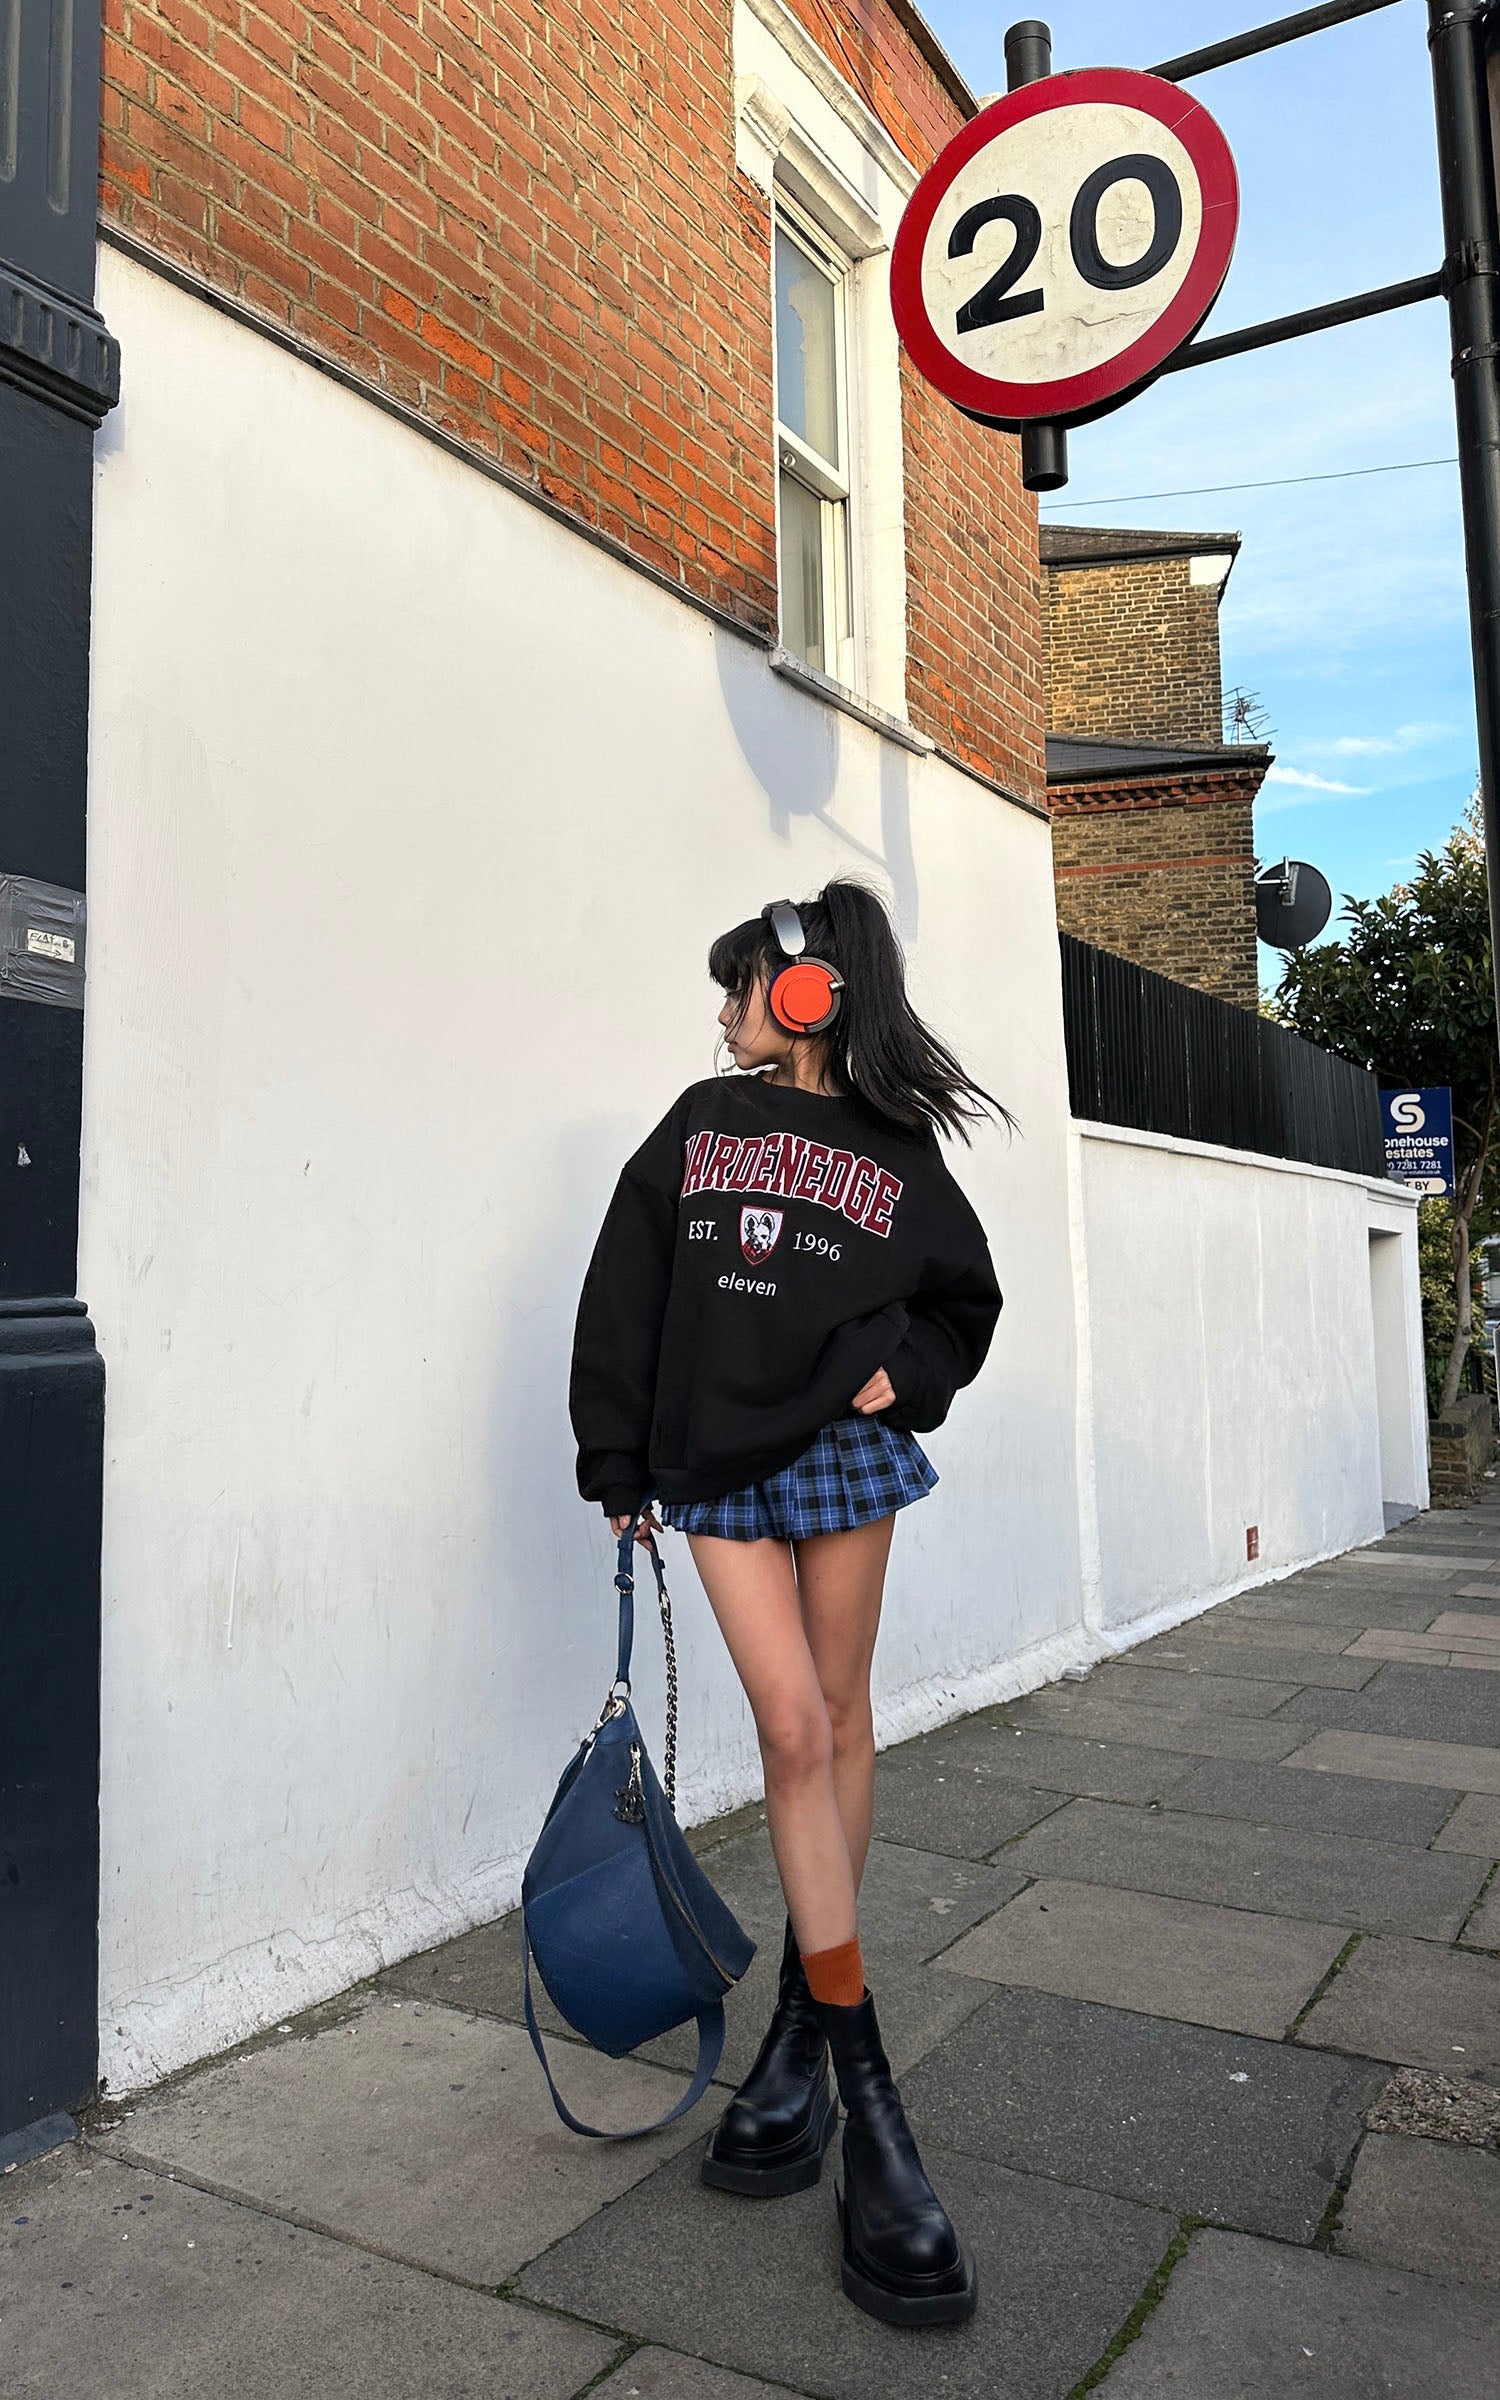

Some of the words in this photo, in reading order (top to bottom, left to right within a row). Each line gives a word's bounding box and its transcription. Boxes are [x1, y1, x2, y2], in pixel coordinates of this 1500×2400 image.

[947, 153, 1183, 335] 20
[1384, 1136, 1449, 1148] onehouse
[1385, 1147, 1435, 1159] estates
[1396, 1160, 1418, 1170] 7281
[1420, 1160, 1442, 1170] 7281
[1415, 1181, 1430, 1191] BY
[689, 1221, 719, 1241] EST.
[792, 1231, 843, 1262] 1996
[717, 1272, 777, 1297] eleven
